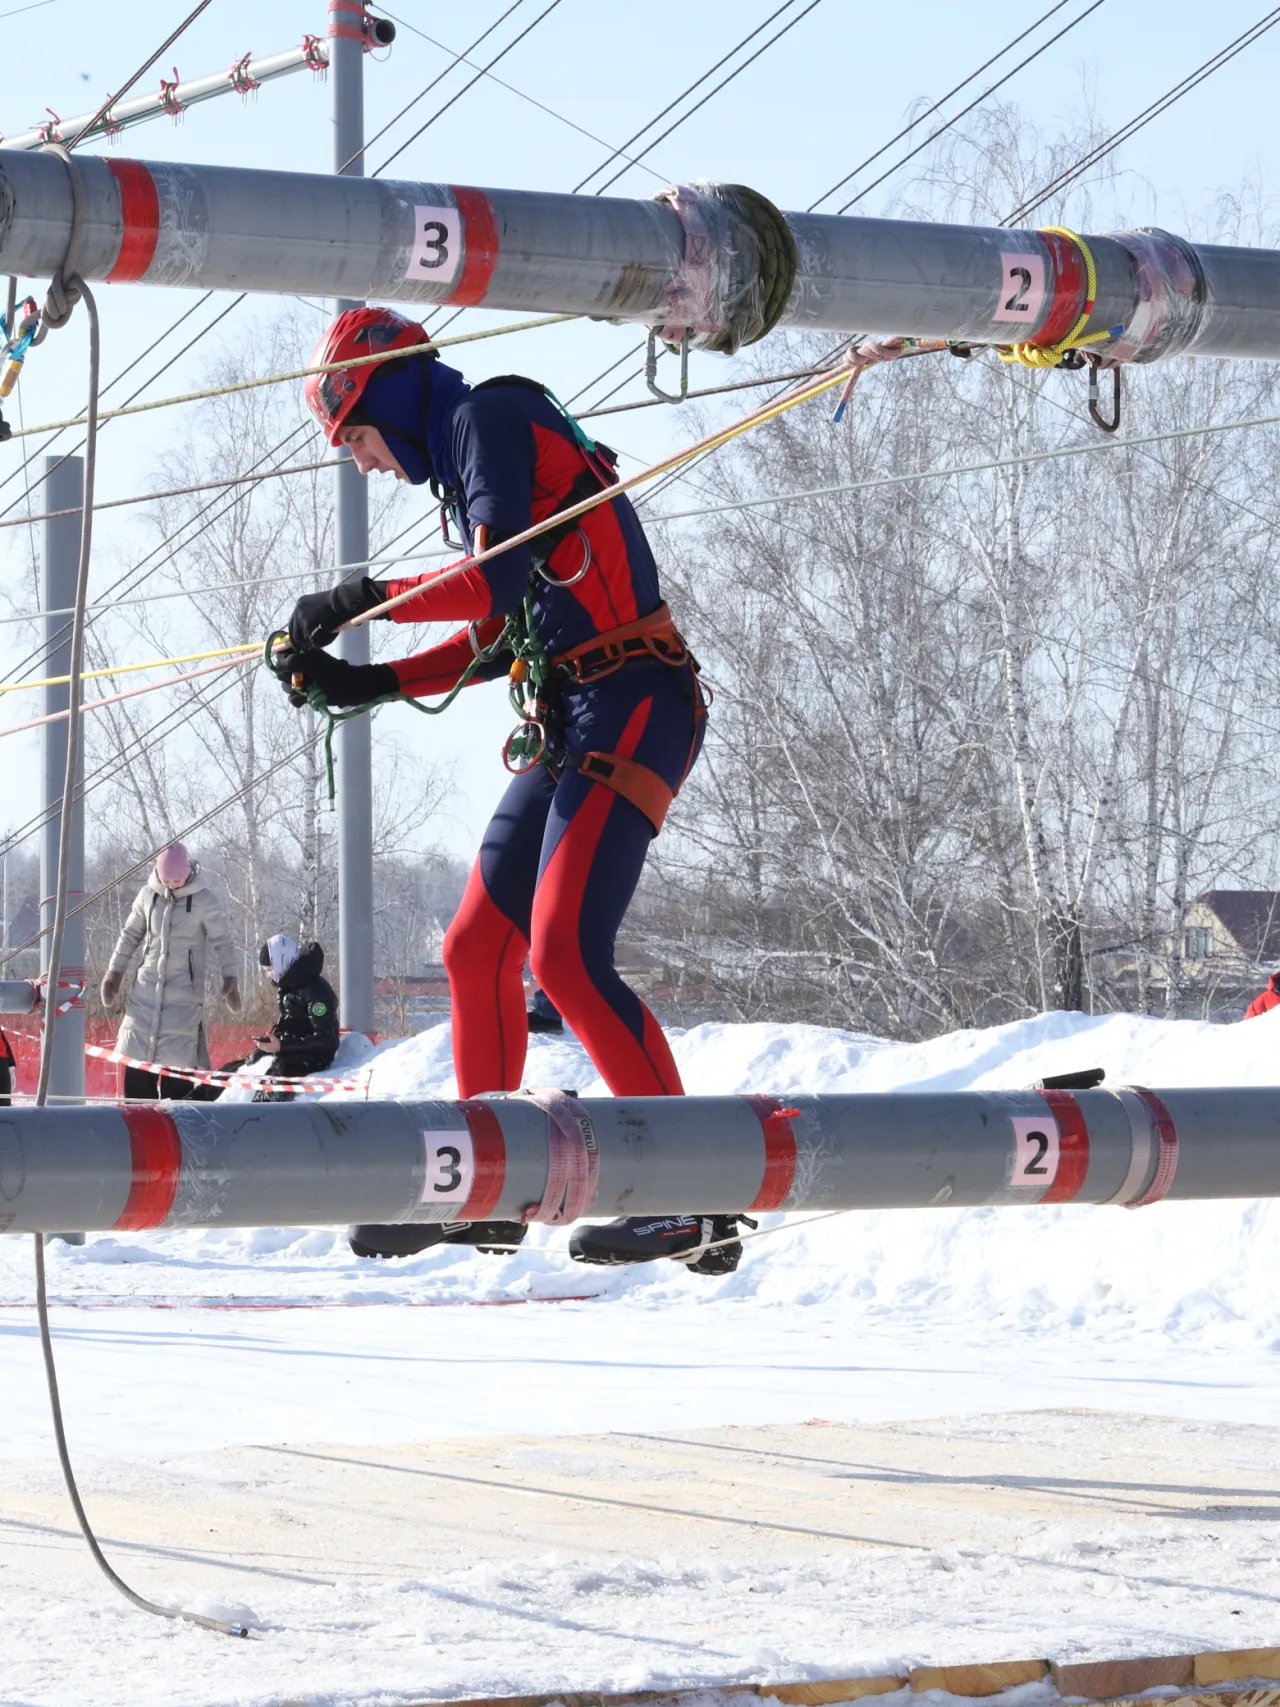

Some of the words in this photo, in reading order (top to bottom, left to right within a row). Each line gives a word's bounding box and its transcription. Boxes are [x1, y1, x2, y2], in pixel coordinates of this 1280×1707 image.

[419, 220, 449, 269] 3
[1005, 267, 1032, 311] 2
[580, 1119, 593, 1149] GURU
[1023, 1130, 1049, 1175] 2
[433, 1145, 462, 1193] 3
[633, 1215, 698, 1237] SPINE
